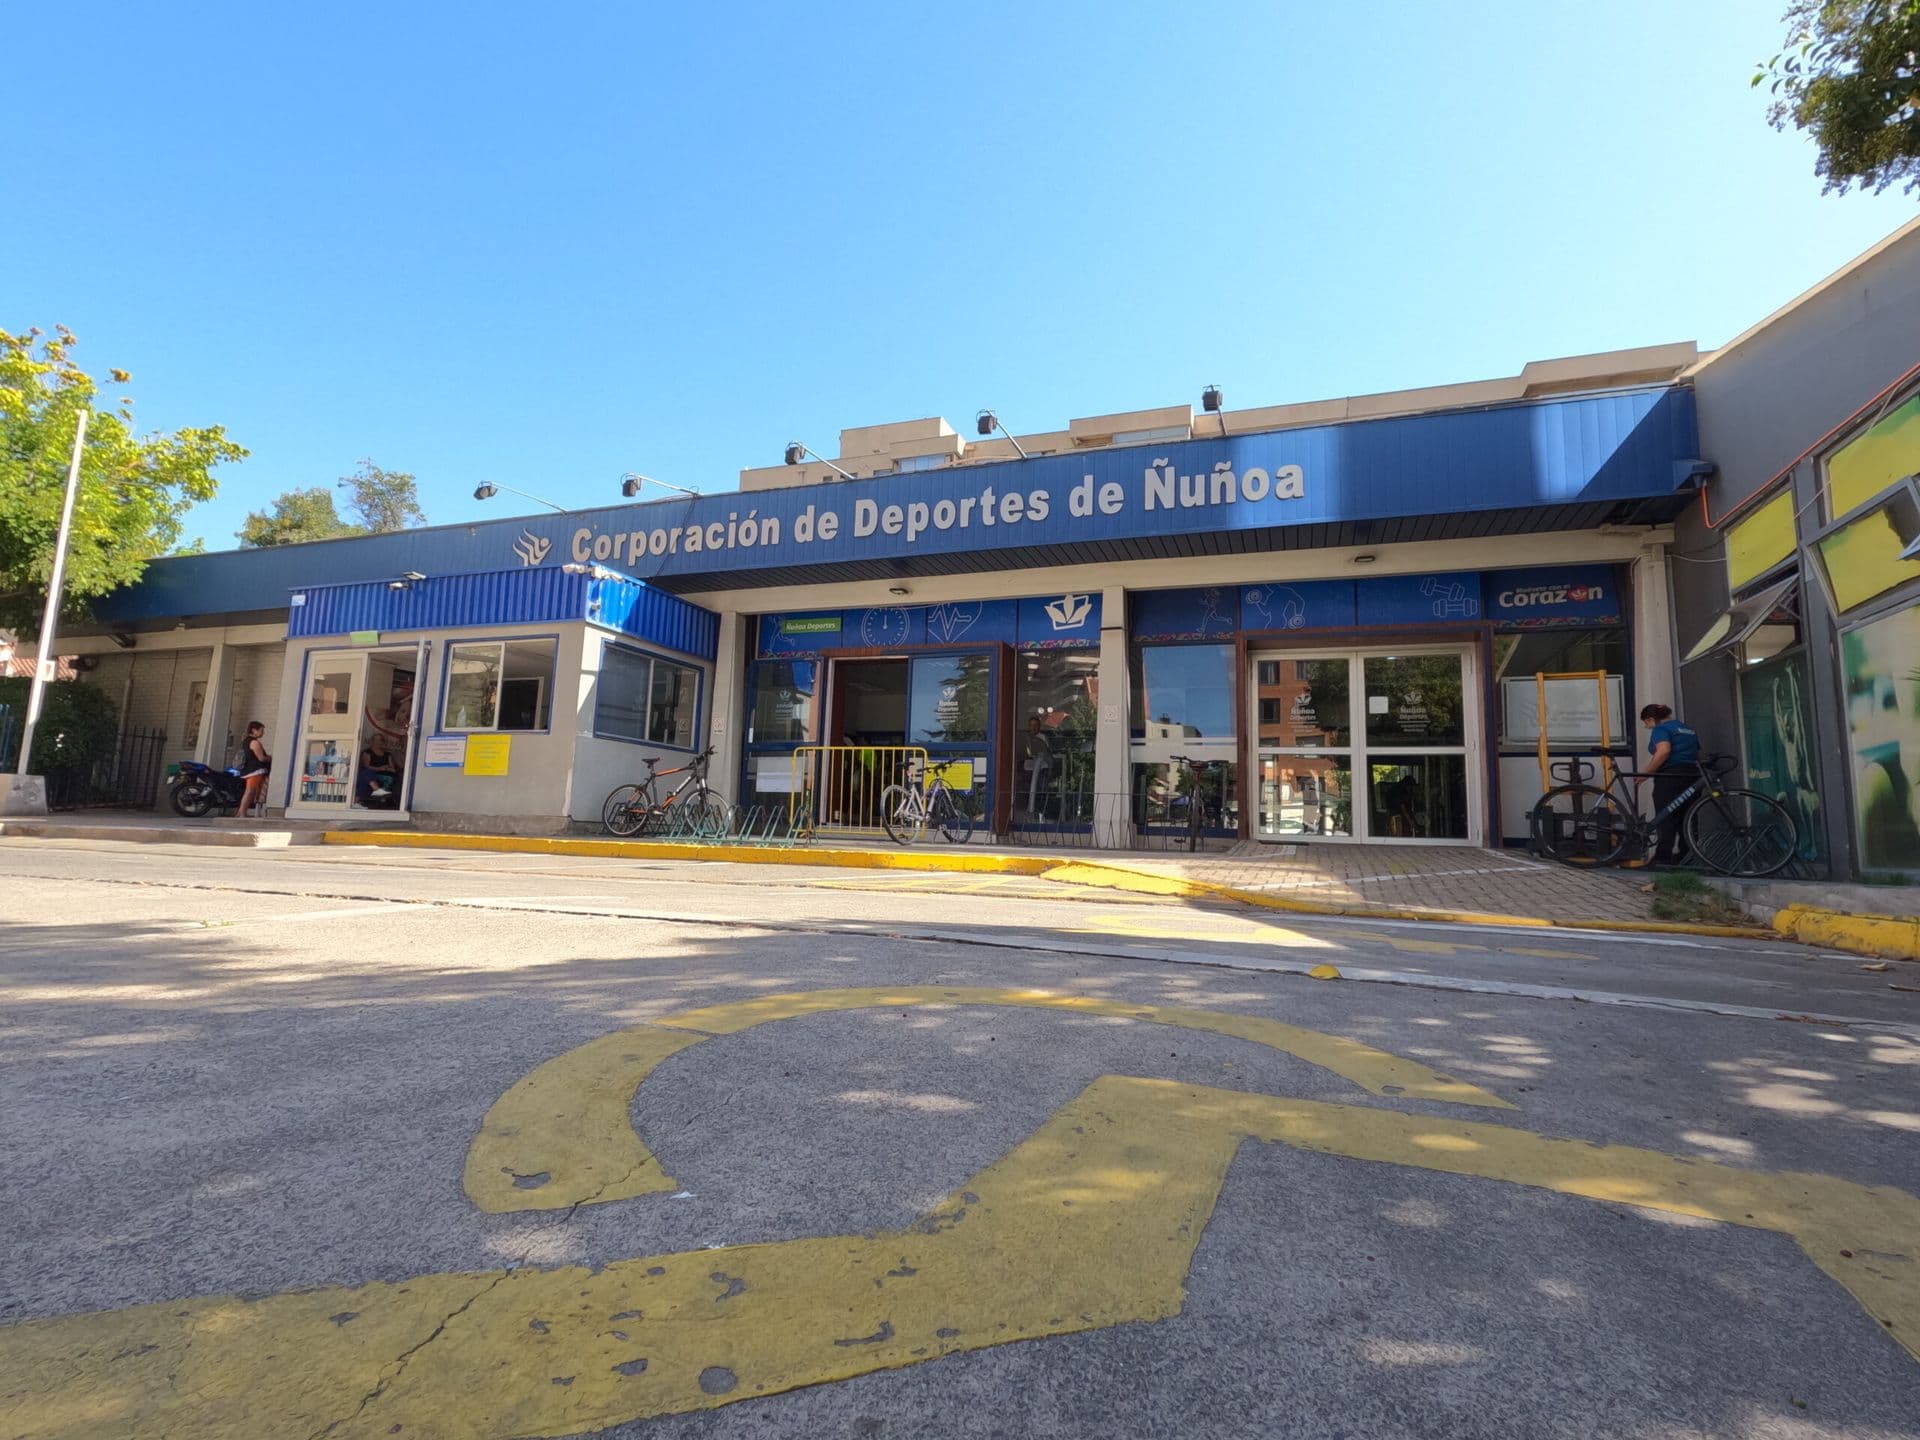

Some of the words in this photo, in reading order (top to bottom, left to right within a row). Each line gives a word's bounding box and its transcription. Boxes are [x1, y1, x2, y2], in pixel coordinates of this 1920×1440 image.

[572, 510, 780, 567] Corporación
[794, 505, 838, 543] de
[854, 486, 1050, 542] Deportes
[1069, 475, 1125, 518] de
[1144, 457, 1304, 511] Ñuñoa
